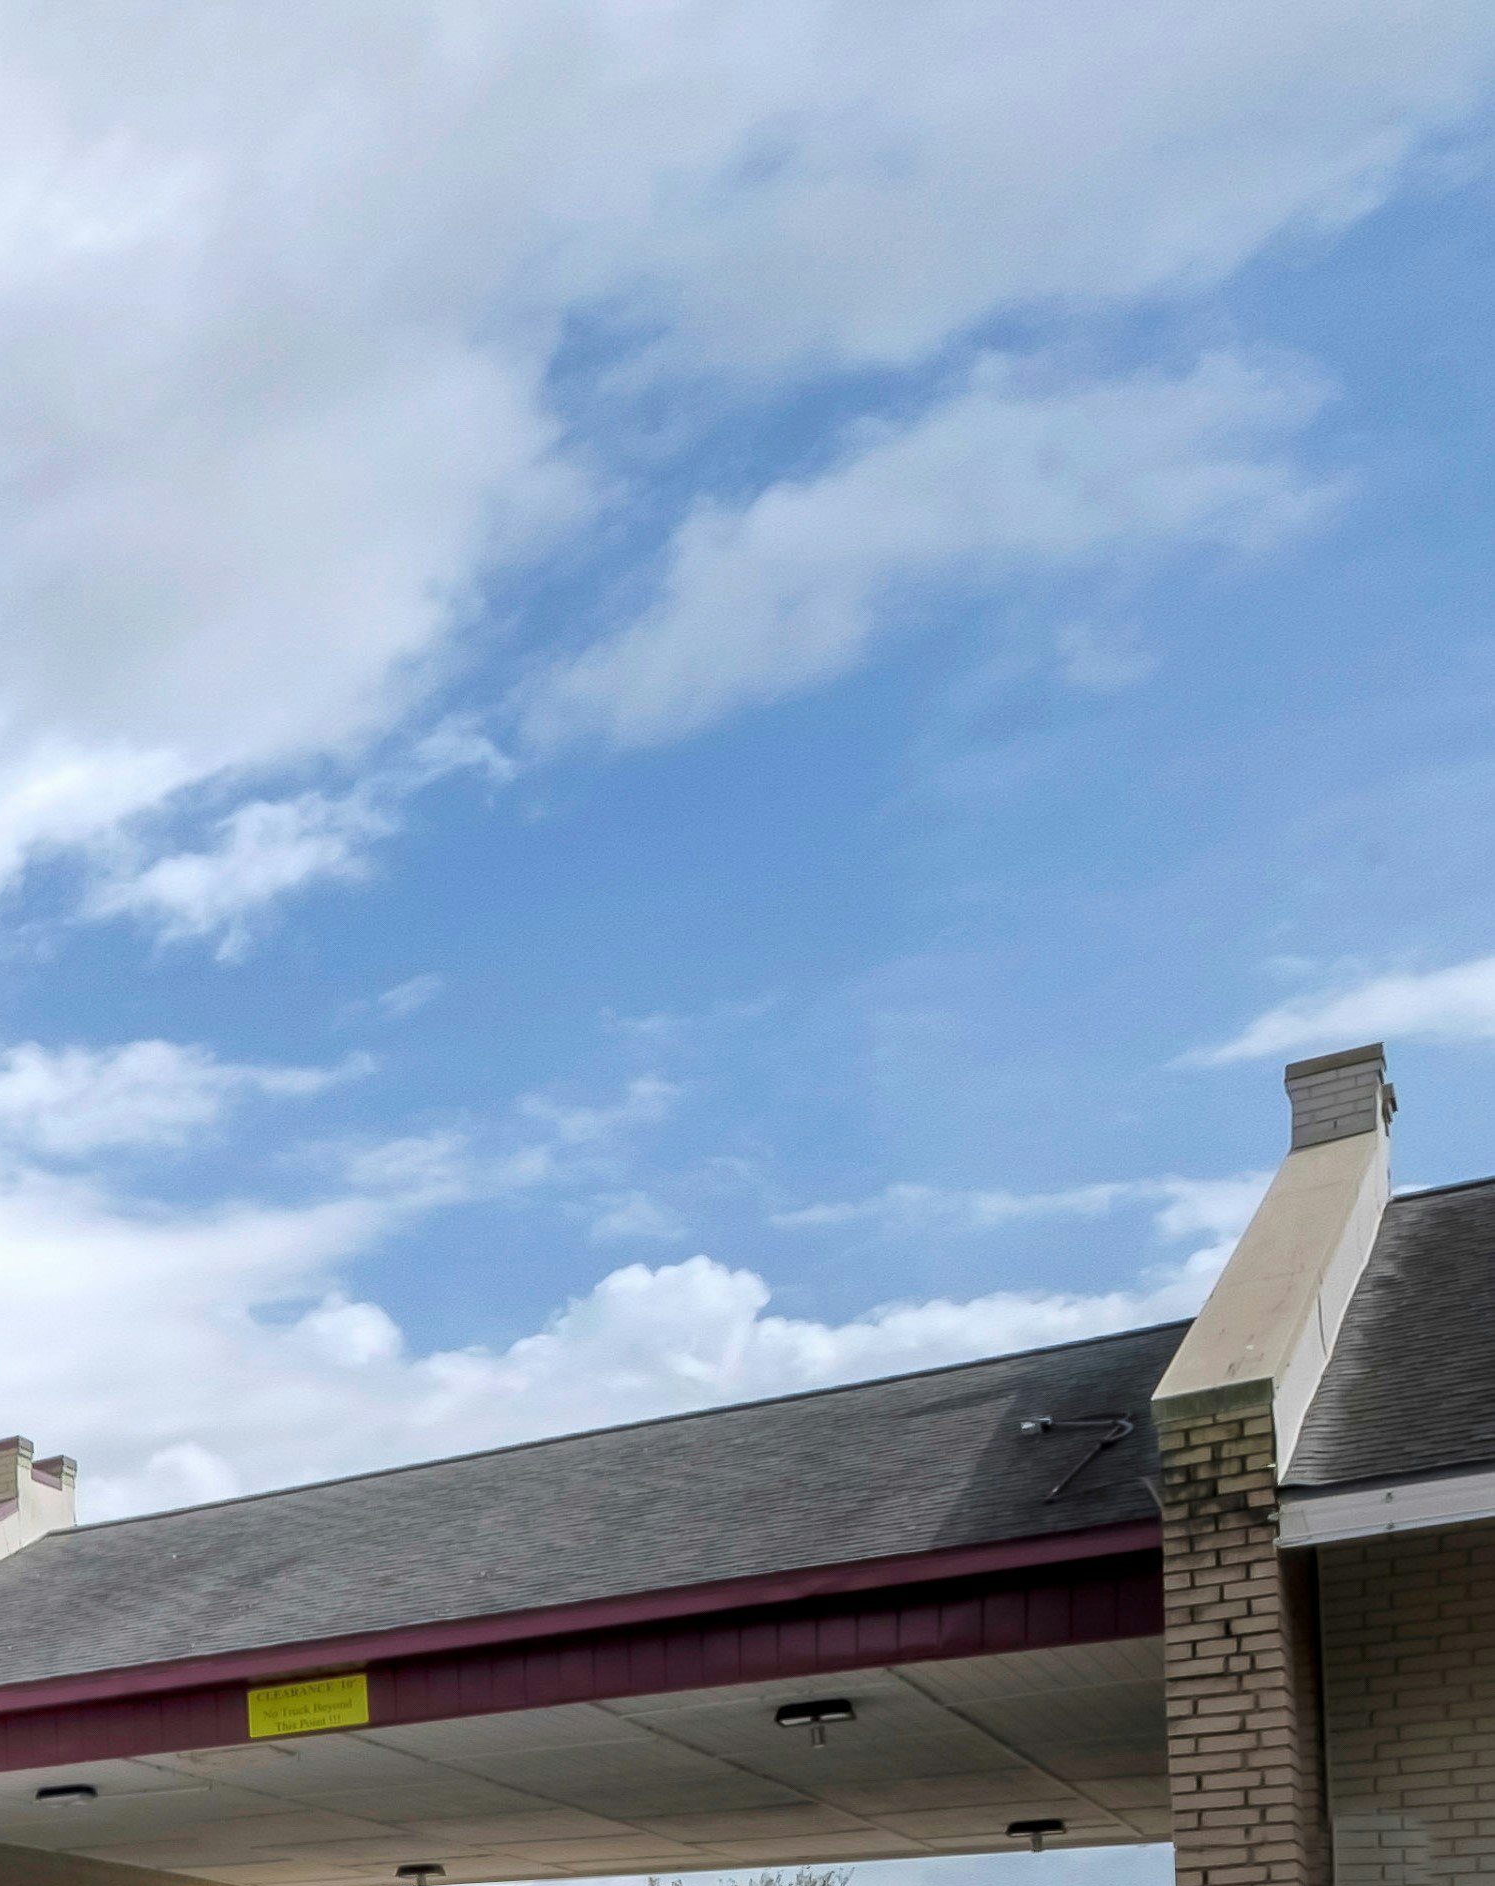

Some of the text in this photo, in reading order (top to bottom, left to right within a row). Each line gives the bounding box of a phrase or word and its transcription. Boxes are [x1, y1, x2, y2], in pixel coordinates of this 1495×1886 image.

[256, 1682, 334, 1702] CLEARANCE
[263, 1698, 353, 1719] No Truck Beyond
[276, 1720, 296, 1732] This
[299, 1716, 327, 1729] Point
